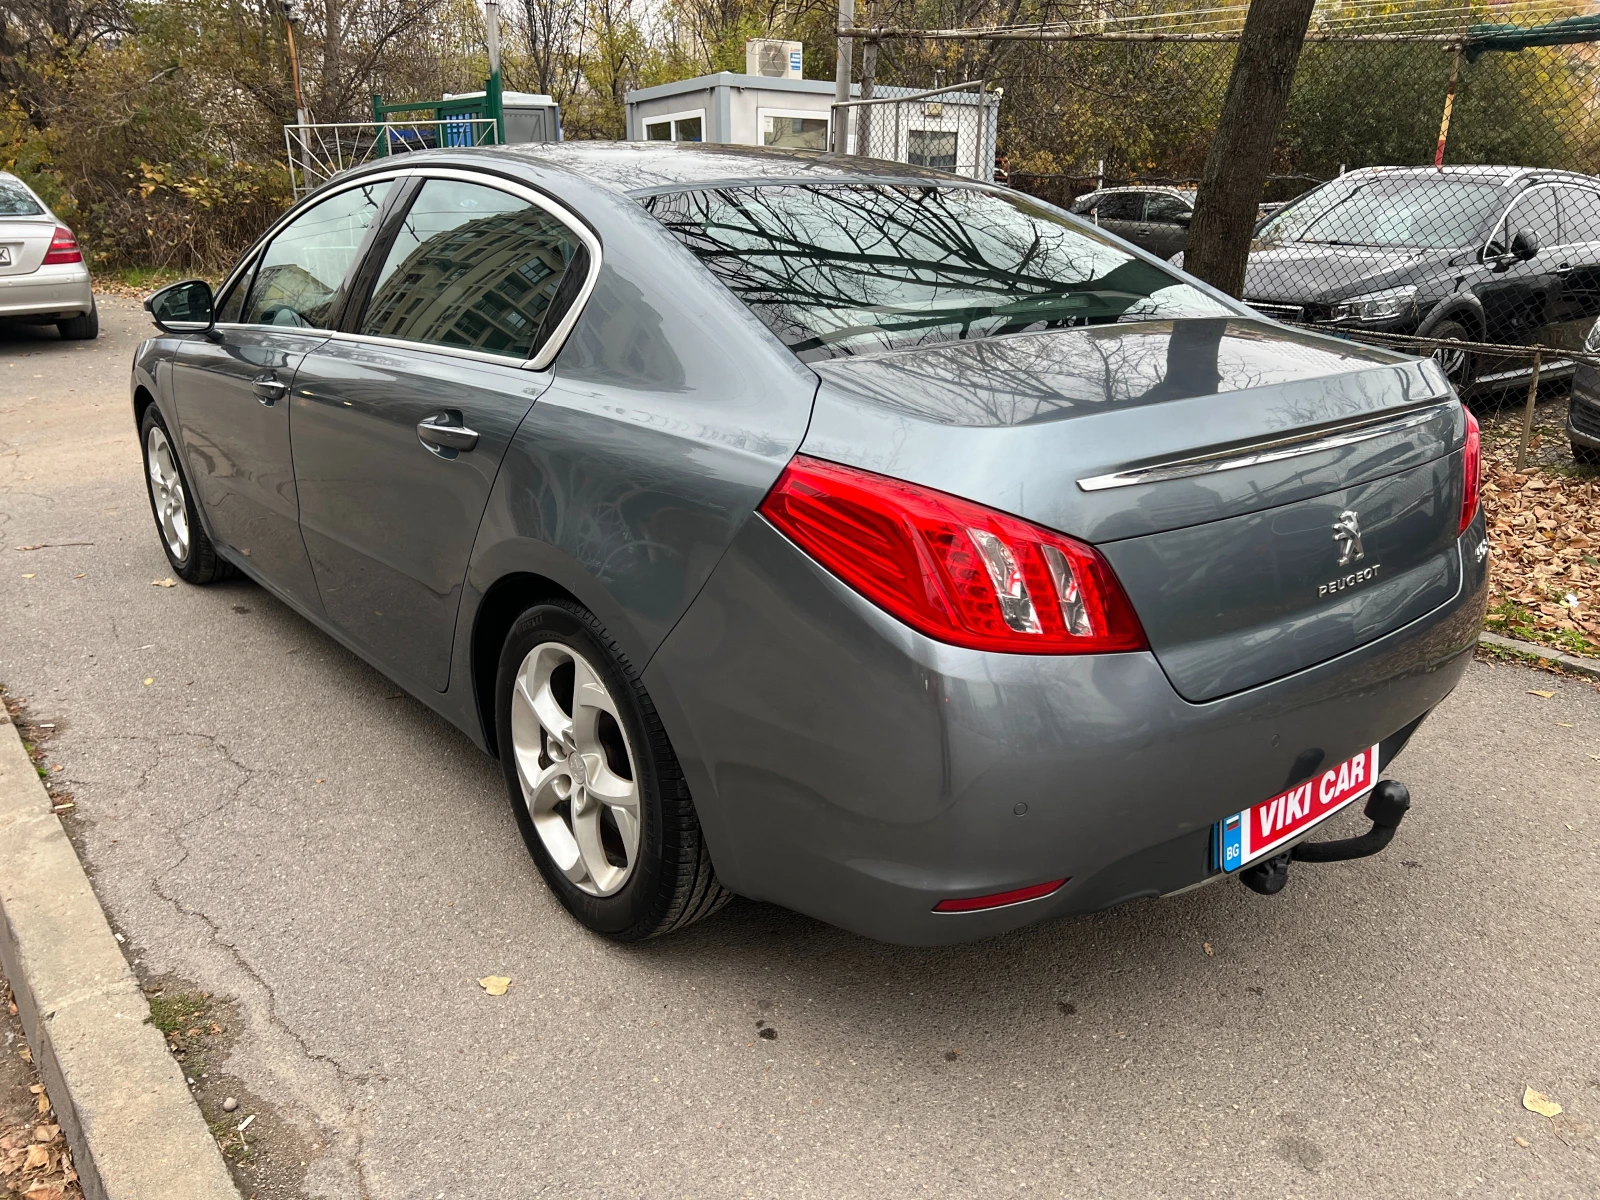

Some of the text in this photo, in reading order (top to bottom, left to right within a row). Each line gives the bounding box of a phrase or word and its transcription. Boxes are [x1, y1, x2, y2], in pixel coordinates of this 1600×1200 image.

[1318, 564, 1381, 598] PEUGEOT
[1259, 752, 1366, 837] VIKI CAR
[1226, 843, 1240, 861] BG
